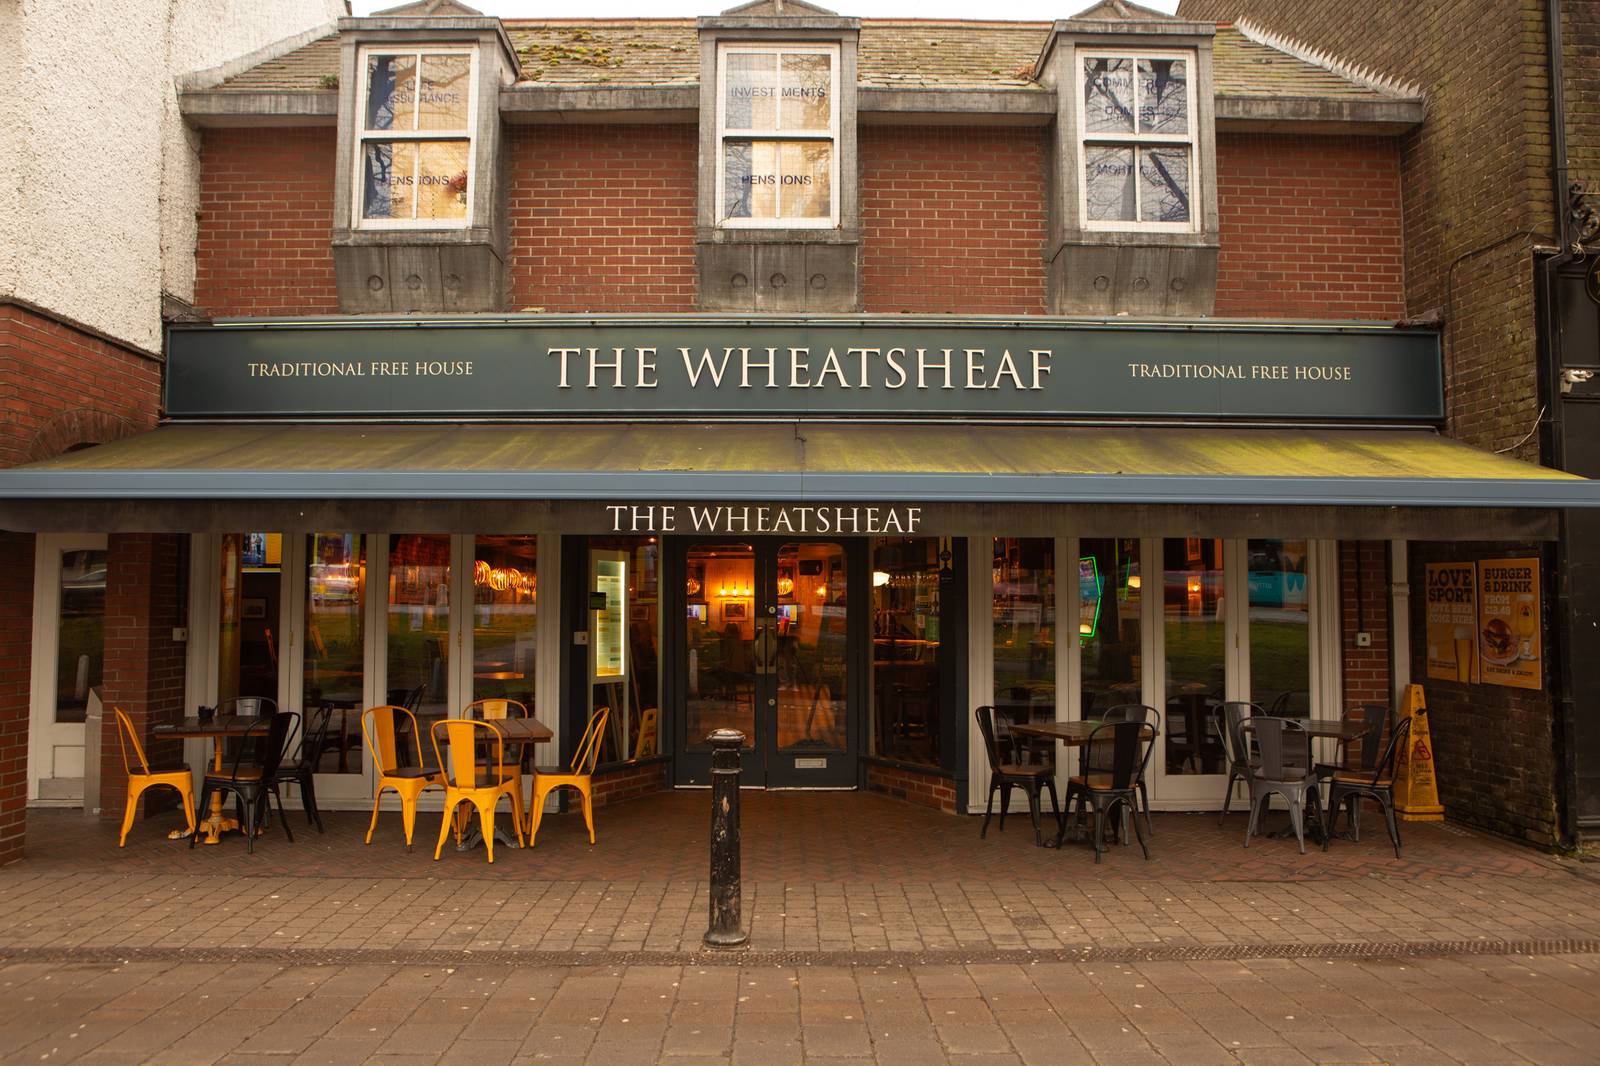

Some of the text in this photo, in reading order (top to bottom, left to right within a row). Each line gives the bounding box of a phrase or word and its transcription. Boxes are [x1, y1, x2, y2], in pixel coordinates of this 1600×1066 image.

[731, 87, 826, 97] INVESTMENTS
[380, 175, 449, 186] ENSIONS
[741, 174, 812, 185] PENSIONS
[248, 360, 473, 377] TRADITIONAL FREE HOUSE
[547, 347, 1053, 390] THE WHEATSHEAF
[1128, 363, 1352, 381] TRADITIONAL FREE HOUSE
[606, 505, 922, 534] THE WHEATSHEAF
[1428, 569, 1472, 586] LOVE
[1484, 568, 1532, 579] BURGER
[1484, 581, 1532, 592] & DRINK
[1428, 588, 1472, 602] SPORT
[1484, 594, 1510, 605] FROM
